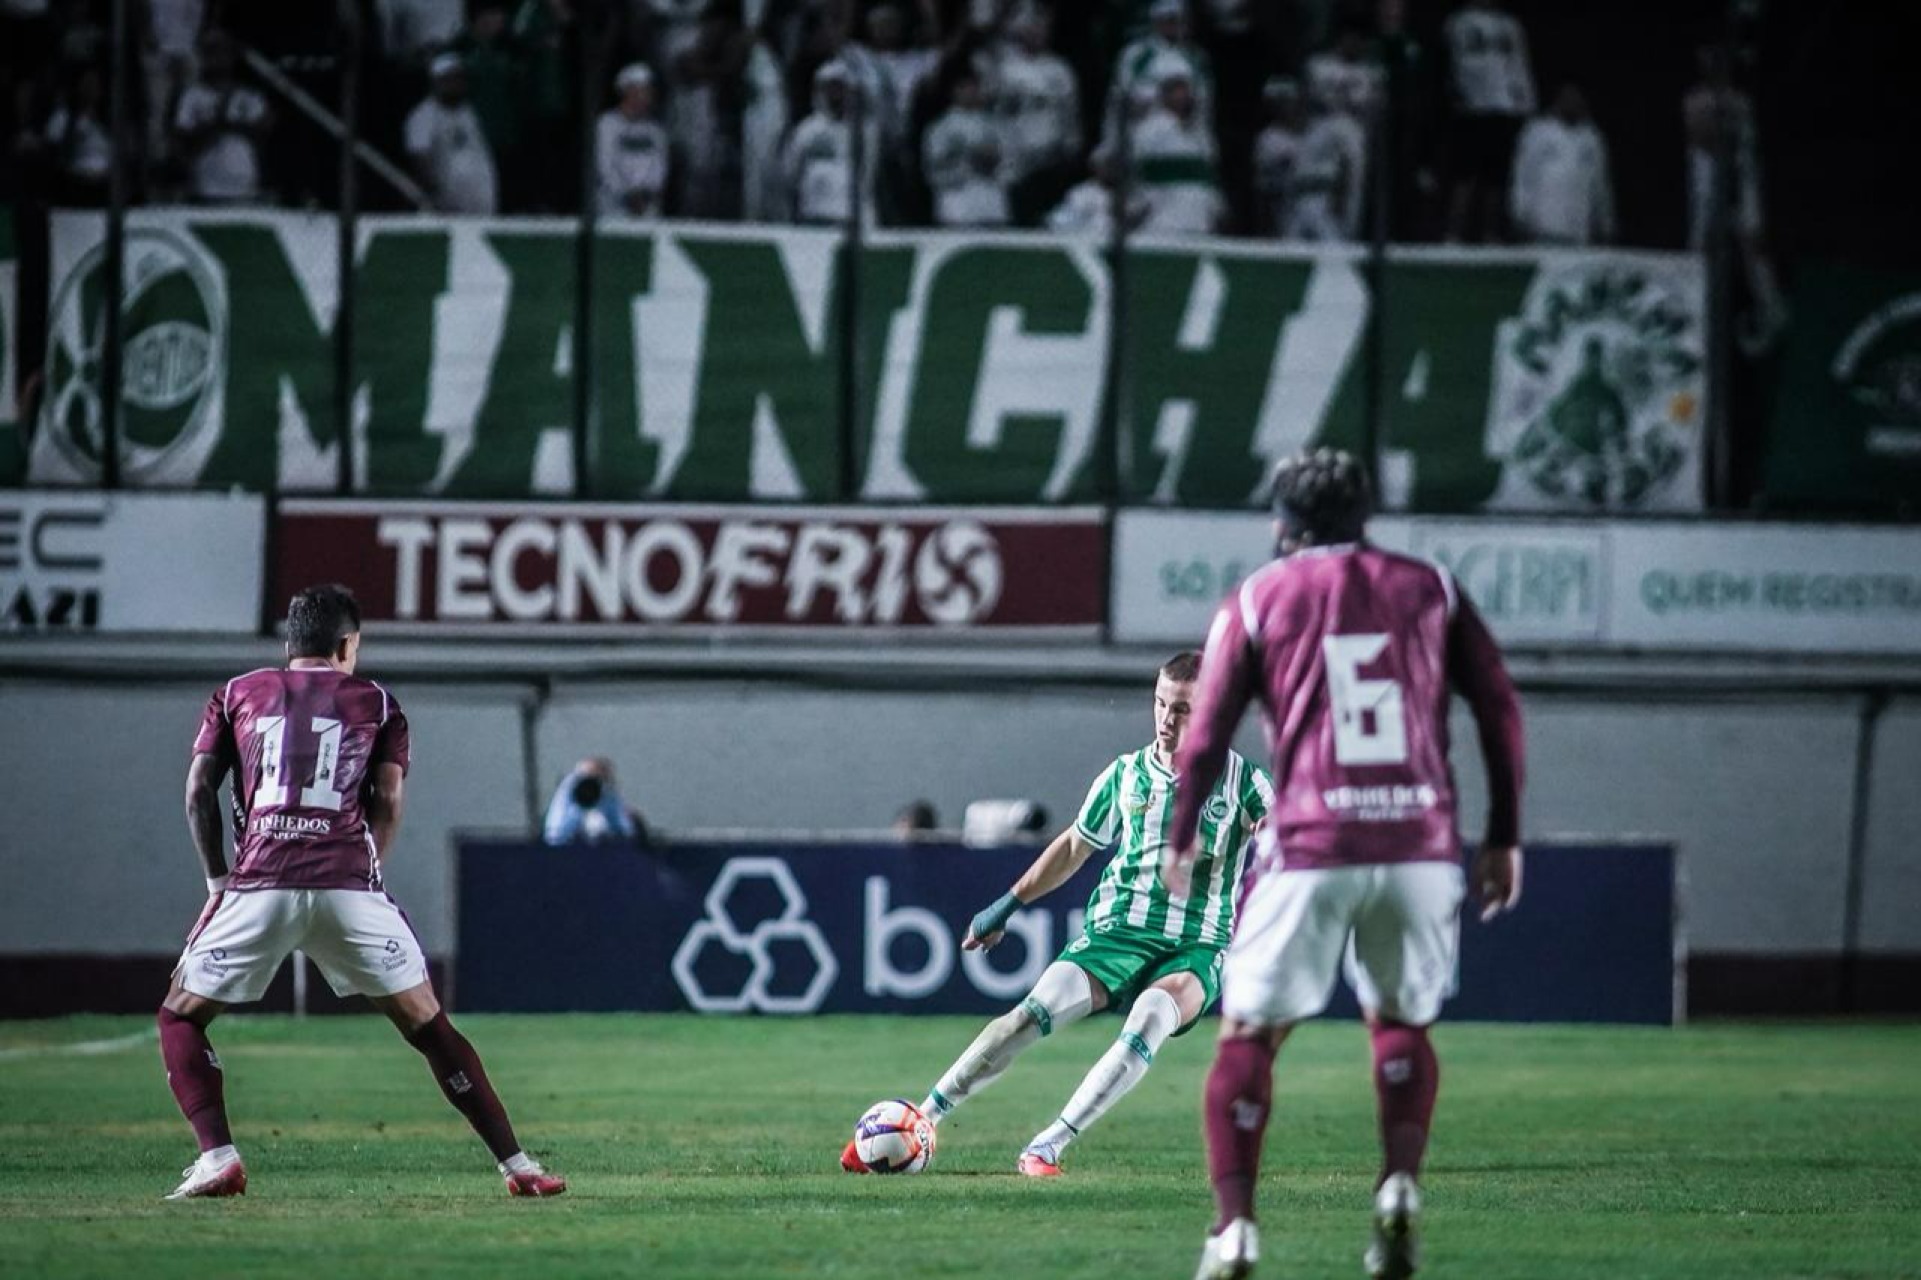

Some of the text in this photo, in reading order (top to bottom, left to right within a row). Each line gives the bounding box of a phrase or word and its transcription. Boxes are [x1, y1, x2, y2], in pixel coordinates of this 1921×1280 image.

[188, 222, 1541, 508] MANCHA
[254, 716, 342, 812] 11
[1322, 633, 1408, 765] 6
